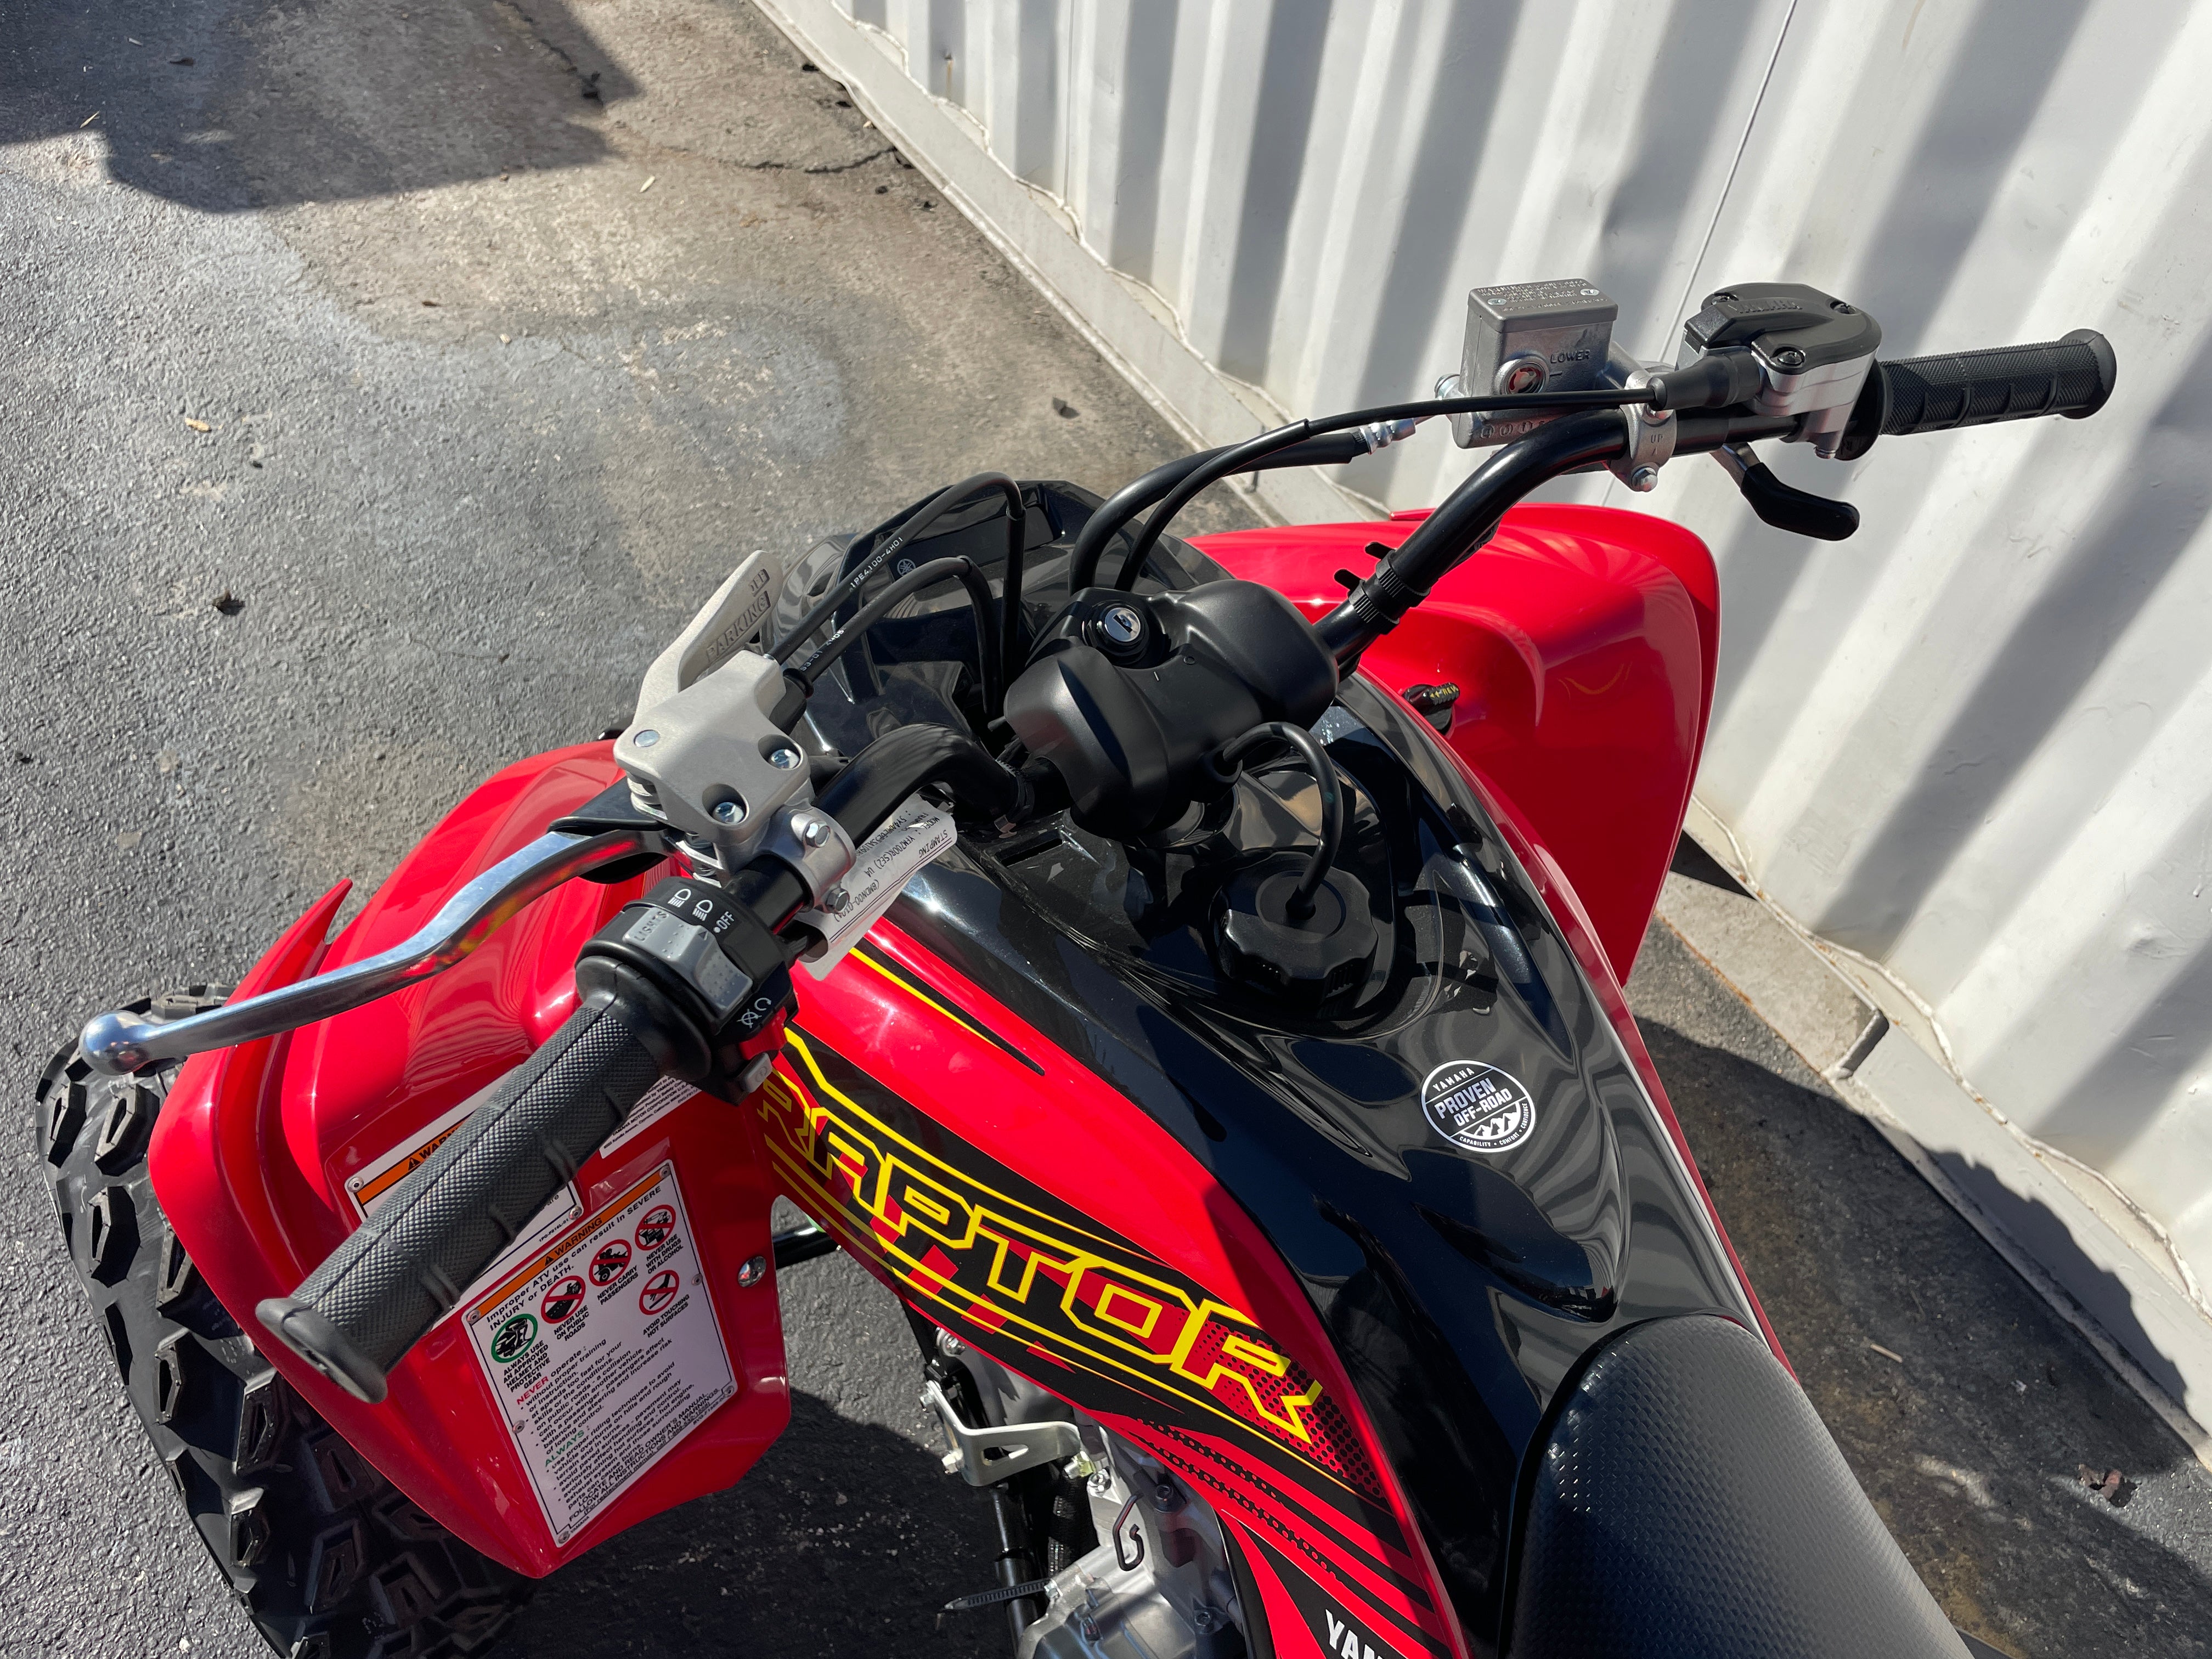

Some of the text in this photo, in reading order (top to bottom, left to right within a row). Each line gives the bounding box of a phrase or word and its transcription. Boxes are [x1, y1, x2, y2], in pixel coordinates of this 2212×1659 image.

[1550, 349, 1590, 364] LOWER
[1651, 434, 1663, 443] UP
[706, 595, 769, 662] PARKING
[918, 830, 948, 859] STAMPING
[716, 911, 735, 930] OFF
[1432, 1067, 1475, 1092] YAMAHA
[1434, 1077, 1497, 1119] PROVEN
[631, 1110, 647, 1124] MOTOR
[1454, 1088, 1513, 1126] OFF-ROAD
[1459, 1136, 1491, 1147] CAPABILITY
[1520, 1103, 1529, 1129] CONFIDENCE
[486, 1285, 530, 1323] Improper
[532, 1269, 550, 1288] ATV
[551, 1256, 569, 1272] use
[571, 1242, 587, 1258] can
[588, 1220, 615, 1244] result
[616, 1213, 625, 1223] in
[626, 1184, 661, 1215] SEVERE
[555, 1216, 603, 1257] WARNING
[645, 1237, 681, 1269] WITH DRUGS
[646, 1233, 678, 1262] NEVER USE
[757, 1068, 1322, 1444] RAPTOR
[596, 1264, 639, 1301] NEVER CARRY
[600, 1271, 639, 1306] PASSENGERS
[647, 1264, 657, 1274] OR
[489, 1299, 526, 1331] INJURY
[527, 1290, 538, 1302] or
[553, 1304, 588, 1335] NEVER USE
[556, 1311, 590, 1340] ON PUBLIC
[642, 1317, 660, 1335] AVOID
[659, 1301, 689, 1328] SURFACES
[563, 1321, 586, 1342] ROADS
[503, 1339, 544, 1376] ALWAYS USE
[503, 1344, 549, 1384] AN APPROVED
[506, 1351, 548, 1389] HELMET AND
[510, 1357, 551, 1393] PROTECTIVE
[516, 1348, 582, 1406] NEVER operate
[525, 1338, 606, 1407] without proper training
[523, 1371, 542, 1389] GEAR
[531, 1340, 622, 1419] at speeds too fast for your
[535, 1420, 546, 1431] on
[546, 1400, 570, 1423] public
[569, 1383, 591, 1403] roads
[601, 1349, 631, 1377] collision
[540, 1427, 556, 1443] with
[563, 1390, 600, 1425] passenger
[605, 1353, 645, 1390] passengers
[645, 1336, 664, 1356] affect
[543, 1338, 672, 1449] balance and steering and increase risk
[528, 1403, 537, 1413] or
[533, 1406, 553, 1425] skills
[553, 1398, 562, 1408] or
[562, 1387, 575, 1401] the
[538, 1421, 552, 1437] can
[552, 1404, 574, 1425] occur
[574, 1391, 590, 1407] with
[590, 1368, 617, 1393] another
[551, 1361, 675, 1470] use proper riding techniques to avoid
[545, 1444, 554, 1455] of
[554, 1426, 577, 1448] losing
[552, 1371, 672, 1476] vehicle overturns on hills and rough
[558, 1466, 578, 1487] avoid
[578, 1447, 600, 1470] paved
[600, 1422, 630, 1450] surfaces
[634, 1390, 667, 1421] pavement
[667, 1378, 681, 1393] may
[544, 1429, 585, 1468] ALWAYS
[555, 1458, 579, 1481] terrain
[579, 1445, 594, 1460] and
[594, 1439, 602, 1448] in
[560, 1462, 592, 1493] seriously
[592, 1444, 613, 1465] affect
[613, 1419, 642, 1447] handling
[642, 1407, 656, 1421] and
[562, 1478, 583, 1499] avoid
[583, 1452, 613, 1481] touching
[613, 1441, 625, 1454] hot
[625, 1416, 654, 1443] surfaces
[658, 1402, 670, 1415] hot
[565, 1477, 593, 1504] exhaust
[592, 1455, 618, 1480] system
[618, 1442, 631, 1458] and
[631, 1426, 651, 1445] those
[651, 1392, 691, 1429] surrounding
[578, 1478, 607, 1508] LOCATE
[607, 1464, 624, 1482] AND
[624, 1446, 644, 1466] READ
[644, 1417, 678, 1448] OWNER'S
[567, 1491, 586, 1510] parts
[586, 1479, 600, 1493] can
[600, 1460, 621, 1481] cause
[568, 1491, 600, 1522] FOLLOW
[600, 1480, 614, 1494] ALL
[614, 1433, 666, 1482] INSTRUCTIONS
[666, 1419, 682, 1436] AND
